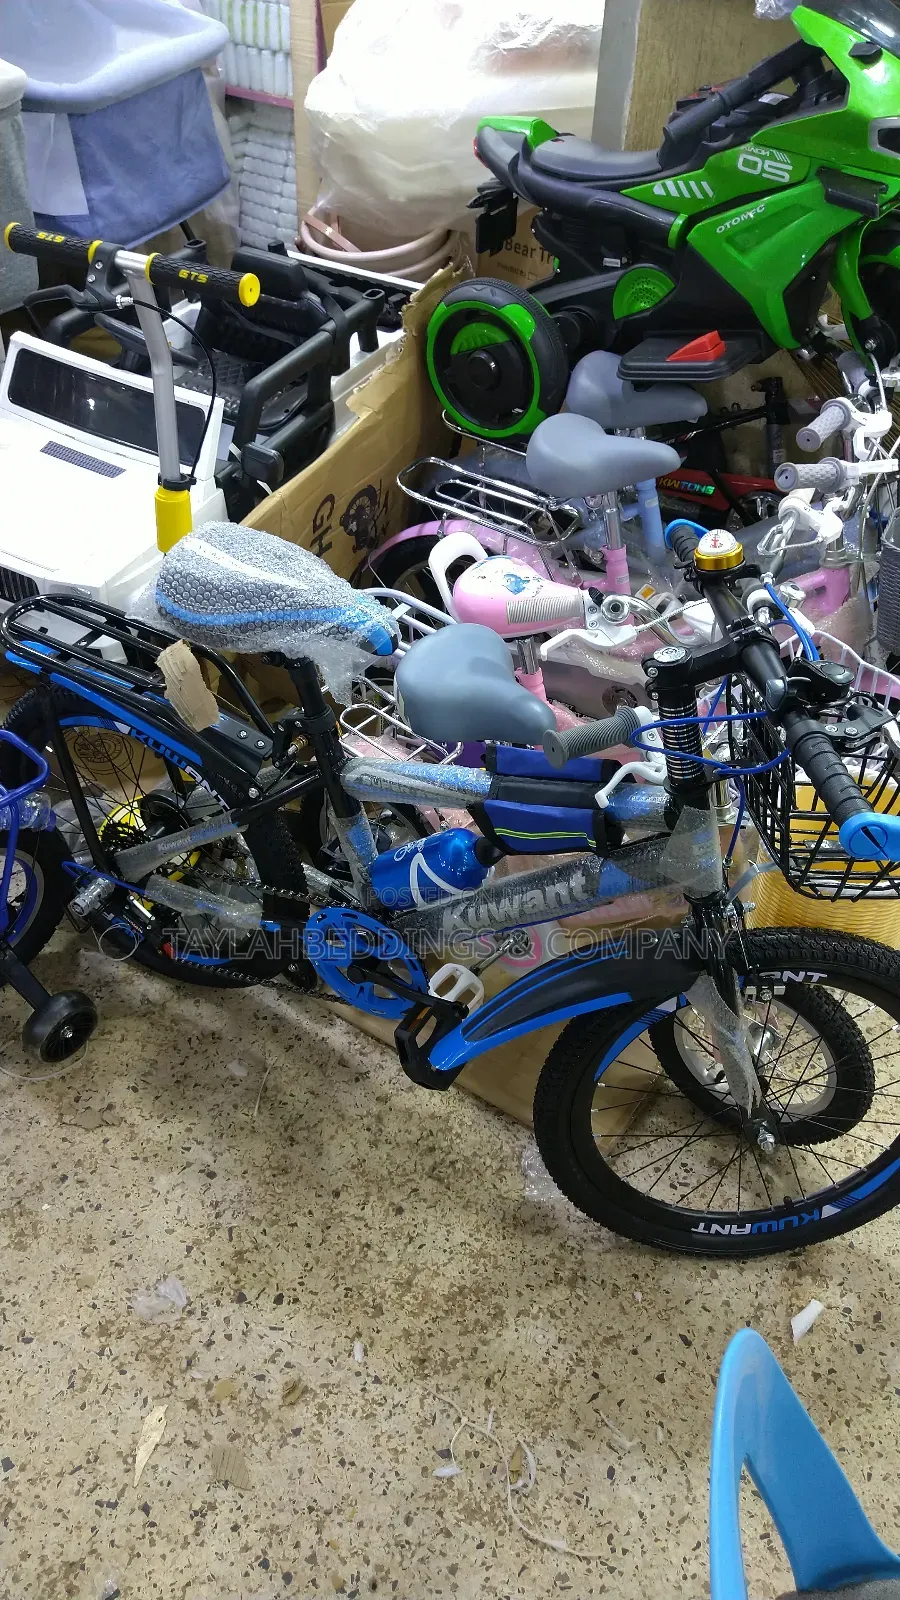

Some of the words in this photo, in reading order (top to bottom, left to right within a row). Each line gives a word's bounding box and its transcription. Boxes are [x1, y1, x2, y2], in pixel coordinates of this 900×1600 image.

[36, 231, 65, 243] GTS
[505, 238, 536, 259] Bear
[178, 269, 209, 283] GTS
[659, 477, 716, 495] KWTONG
[442, 867, 588, 934] Kuwant
[691, 1208, 820, 1235] KUWANT
